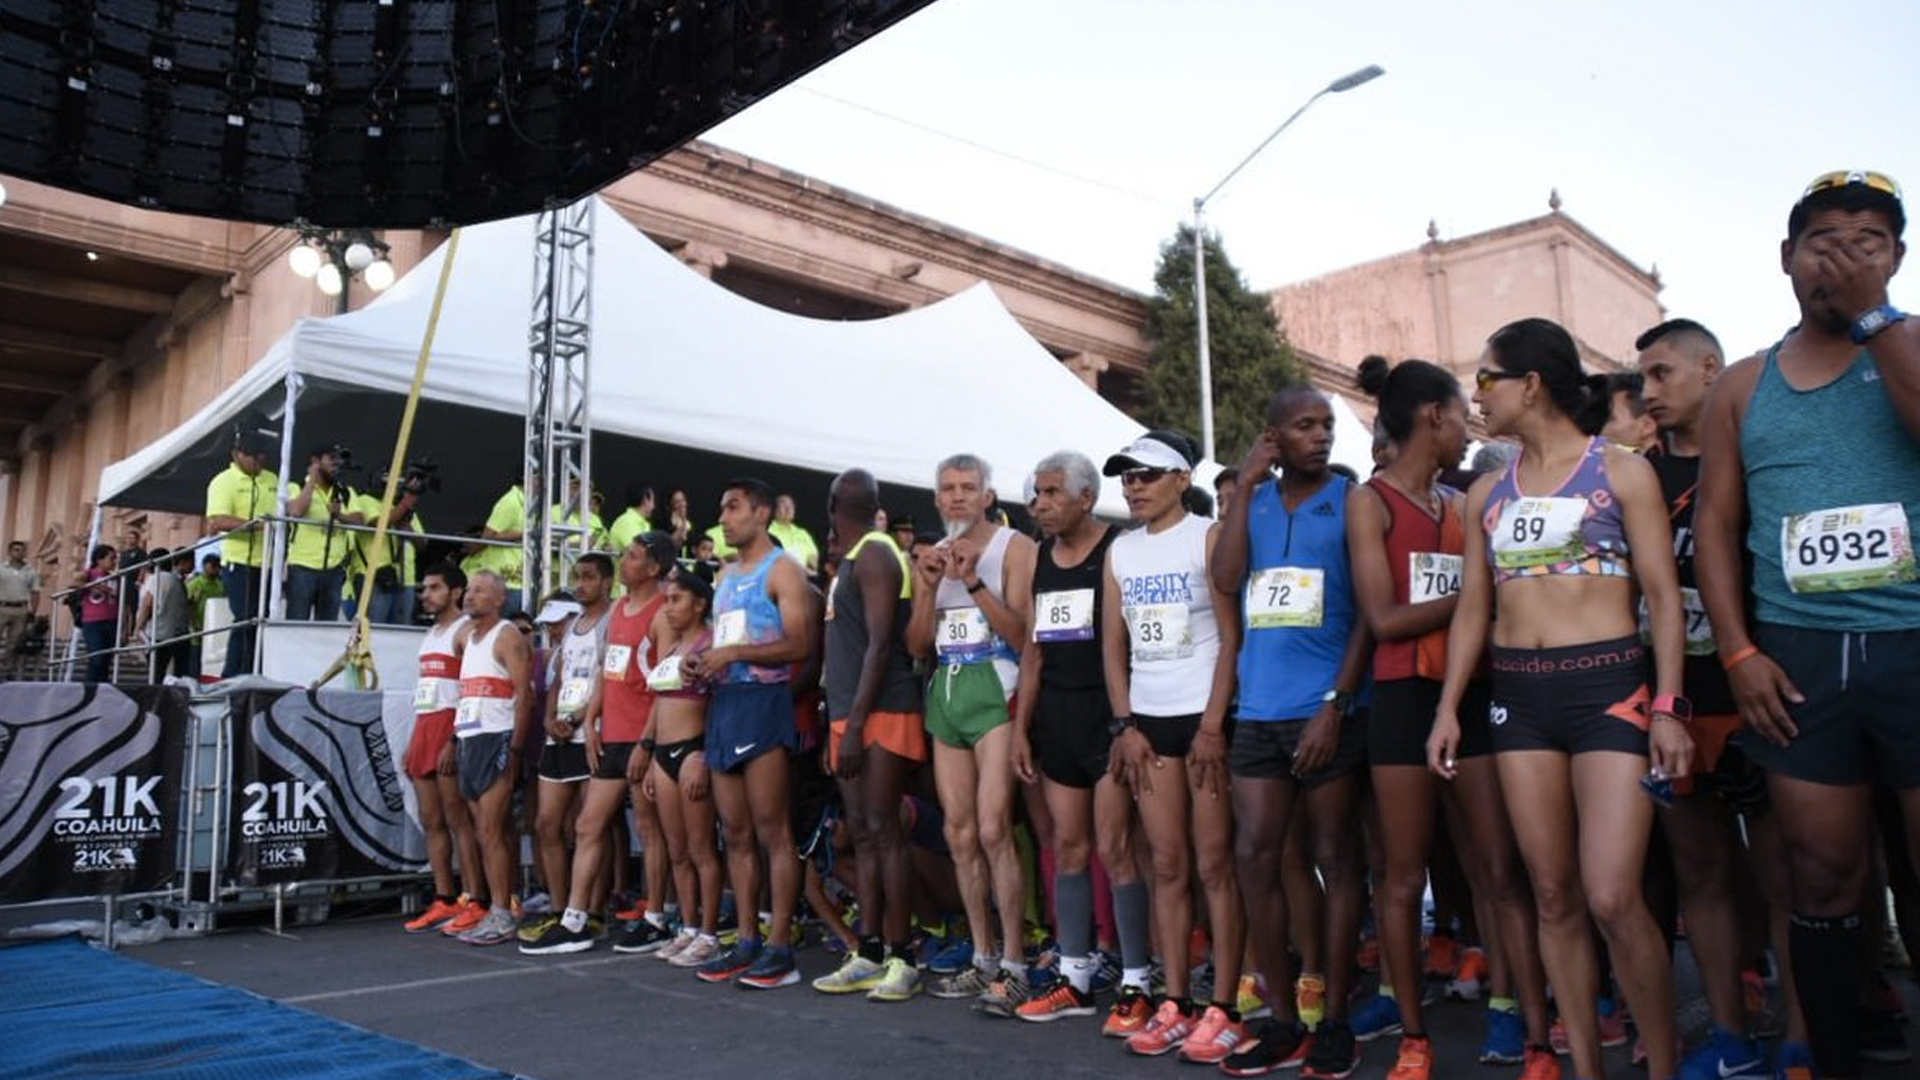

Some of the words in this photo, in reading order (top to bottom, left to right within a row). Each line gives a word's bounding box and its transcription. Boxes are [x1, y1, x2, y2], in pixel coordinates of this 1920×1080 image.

[1513, 517, 1545, 543] 89
[1799, 529, 1889, 567] 6932
[1123, 572, 1189, 595] OBESITY
[1422, 572, 1461, 595] 704
[1268, 585, 1291, 607] 72
[1050, 606, 1071, 624] 85
[948, 623, 968, 640] 30
[1140, 621, 1163, 642] 33
[54, 775, 163, 819] 21K
[242, 780, 327, 822] 21K
[54, 818, 161, 836] COAHUILA
[242, 819, 328, 837] COAHUILA
[74, 848, 112, 867] 21K
[261, 848, 288, 865] 21K
